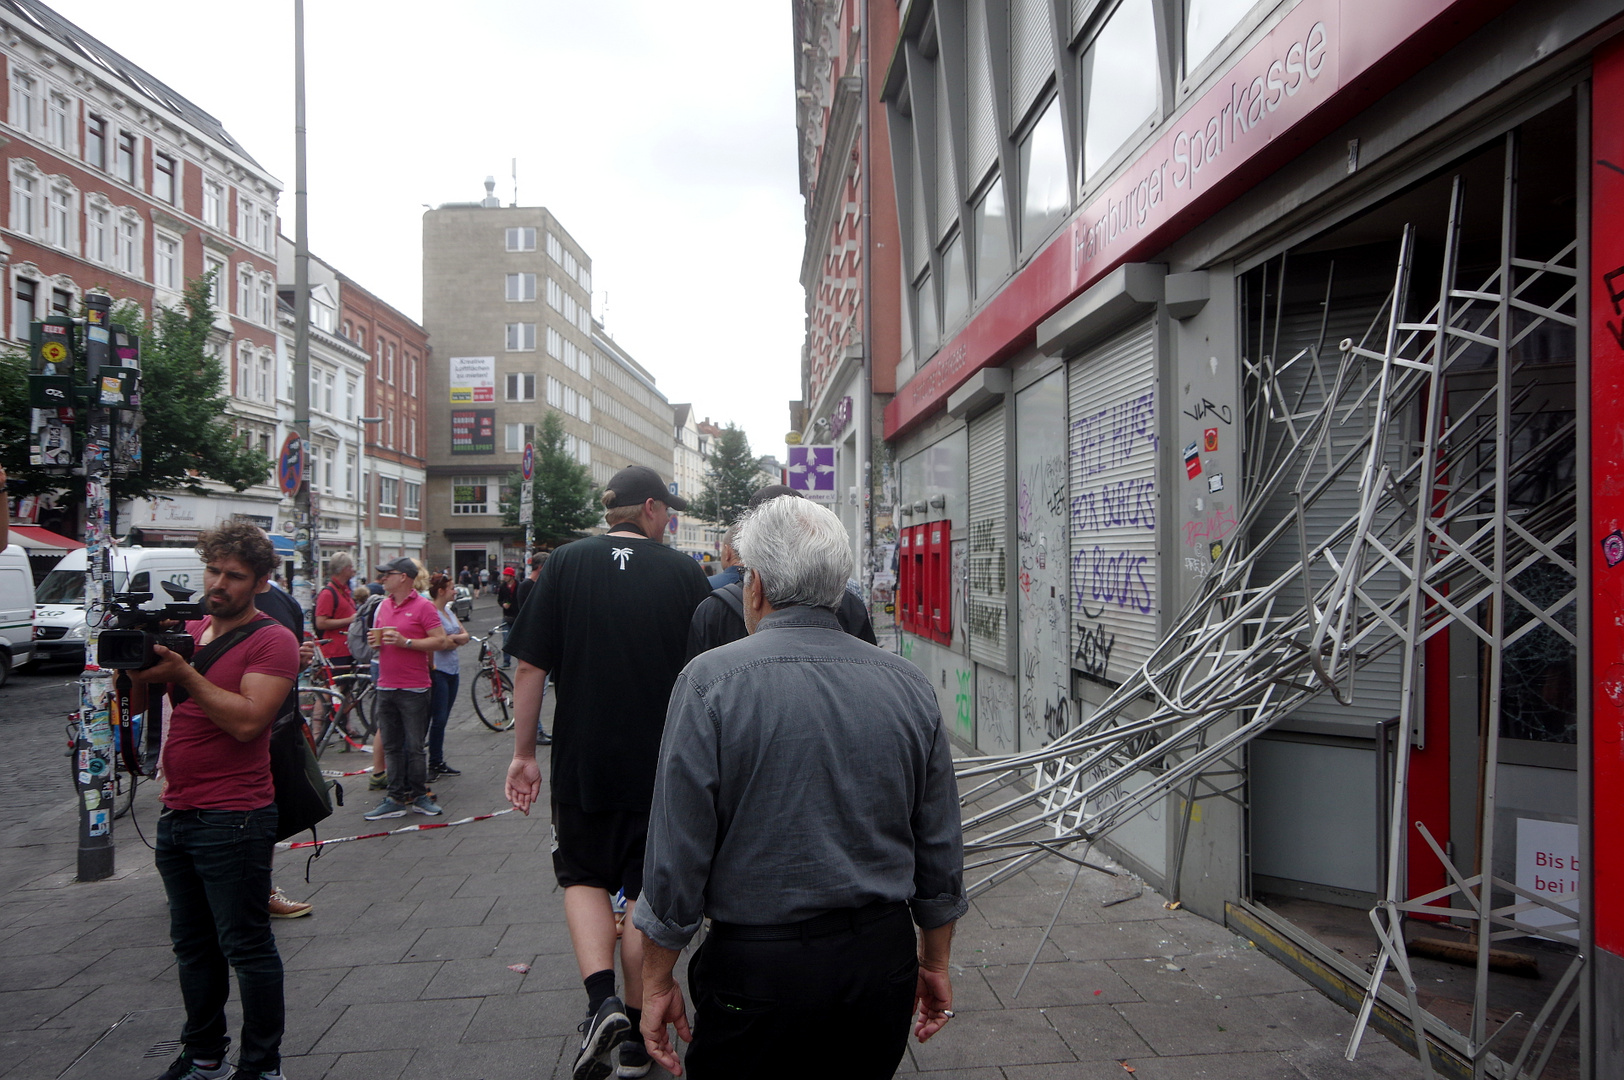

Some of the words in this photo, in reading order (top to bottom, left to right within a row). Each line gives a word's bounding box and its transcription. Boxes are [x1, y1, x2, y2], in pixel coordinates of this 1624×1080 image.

[1075, 158, 1170, 271] Hamburger
[1172, 21, 1327, 190] Sparkasse
[1071, 407, 1107, 489] FREE
[1111, 388, 1158, 467] HUGS
[1072, 491, 1100, 537] FOR
[1102, 478, 1155, 530] BLACKS
[1092, 545, 1151, 615] BLOCKS
[121, 697, 129, 706] 7D
[1535, 851, 1564, 869] Bis
[1535, 875, 1564, 894] bei
